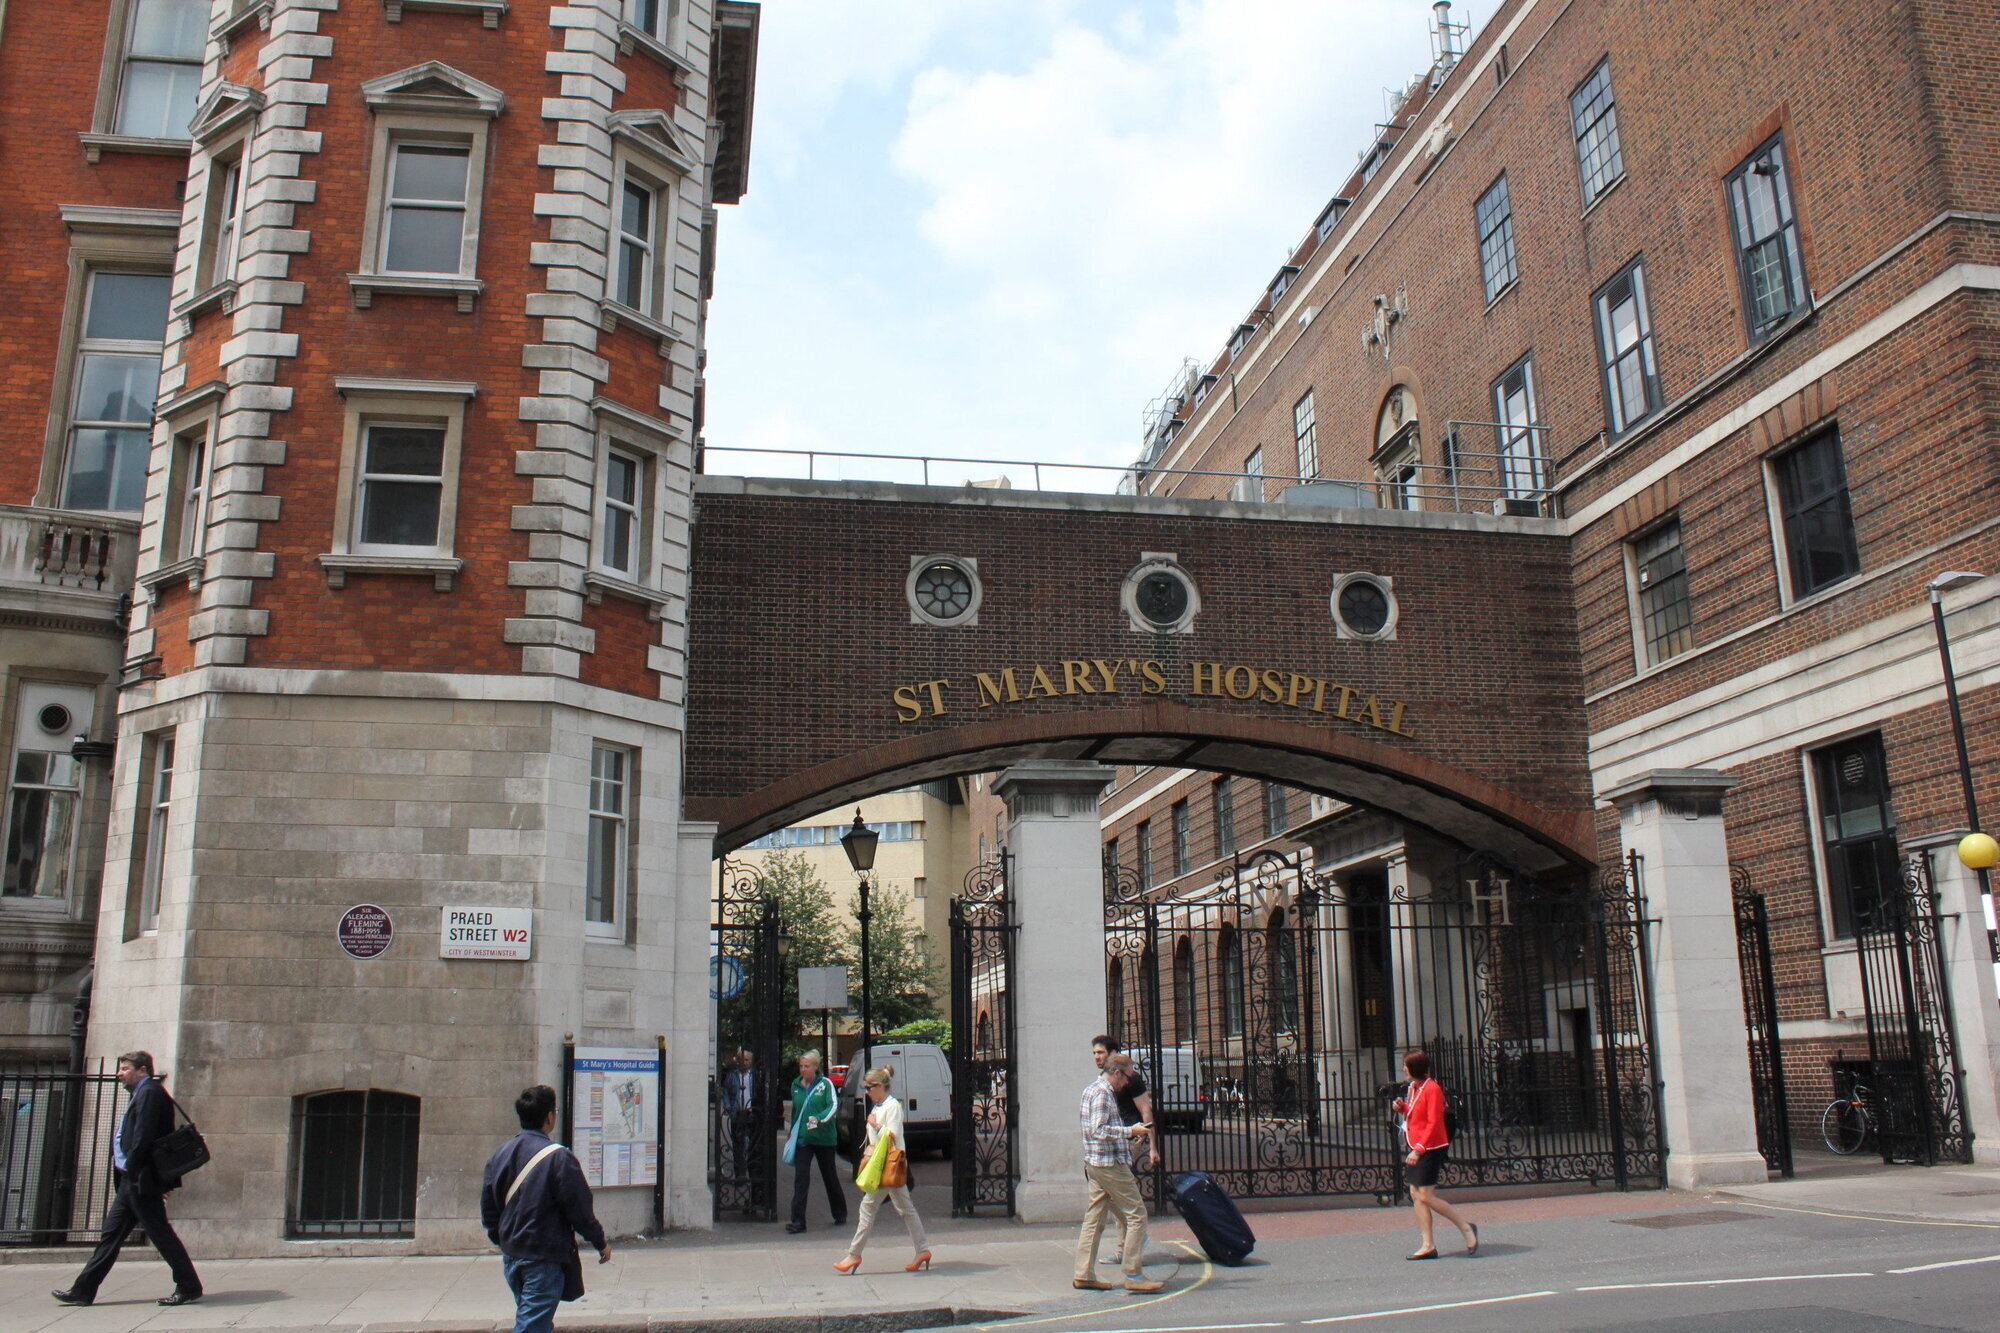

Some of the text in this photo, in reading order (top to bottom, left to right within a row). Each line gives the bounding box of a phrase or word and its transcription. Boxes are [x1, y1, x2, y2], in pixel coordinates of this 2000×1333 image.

[893, 659, 1415, 738] ST MARY'S HOSPITAL
[348, 920, 384, 928] FLEMING
[450, 912, 493, 925] PRAED
[449, 928, 528, 942] STREET W2
[473, 949, 517, 957] WESTMINSTER
[582, 1060, 655, 1070] St Mary's Hospital Guide
